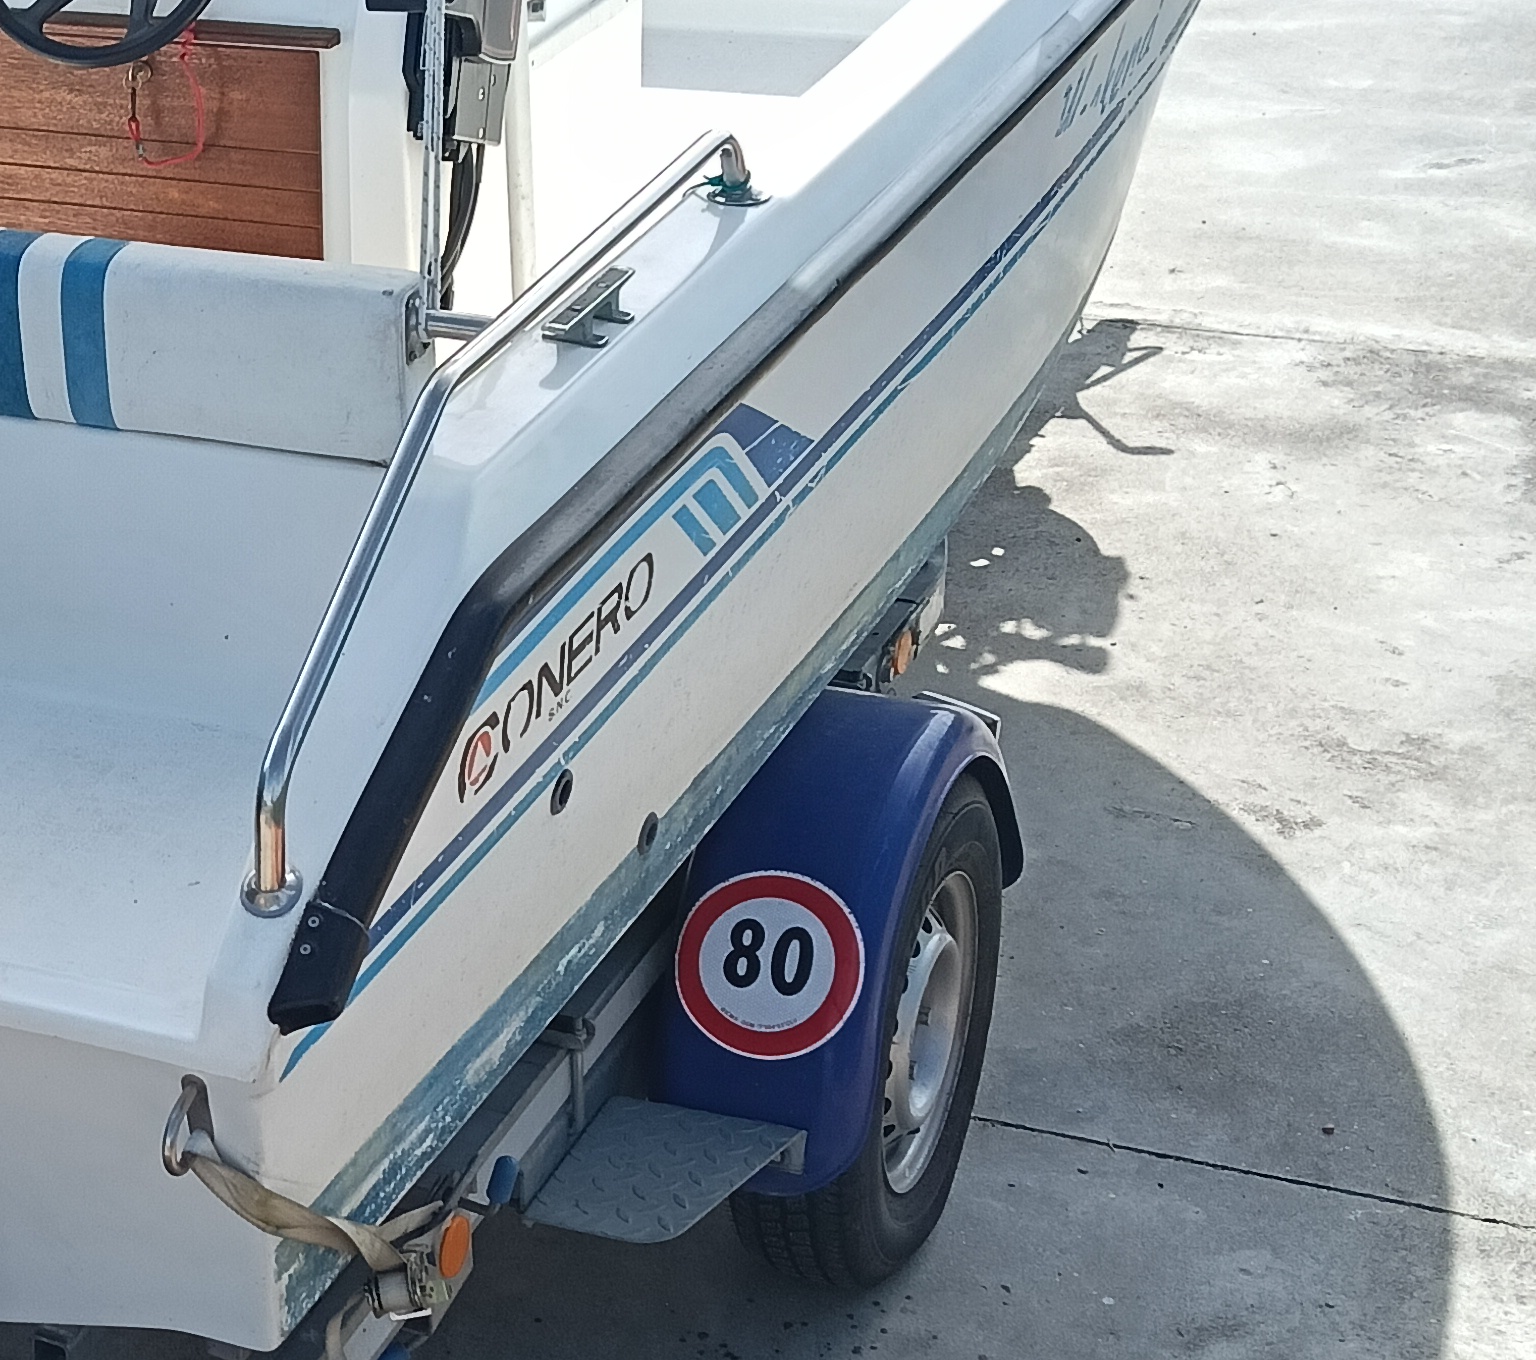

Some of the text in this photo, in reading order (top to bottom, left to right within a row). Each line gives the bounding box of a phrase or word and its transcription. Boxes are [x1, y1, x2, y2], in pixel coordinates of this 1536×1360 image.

[457, 551, 654, 804] CONERO
[548, 689, 571, 722] SNC
[722, 917, 814, 997] 80
